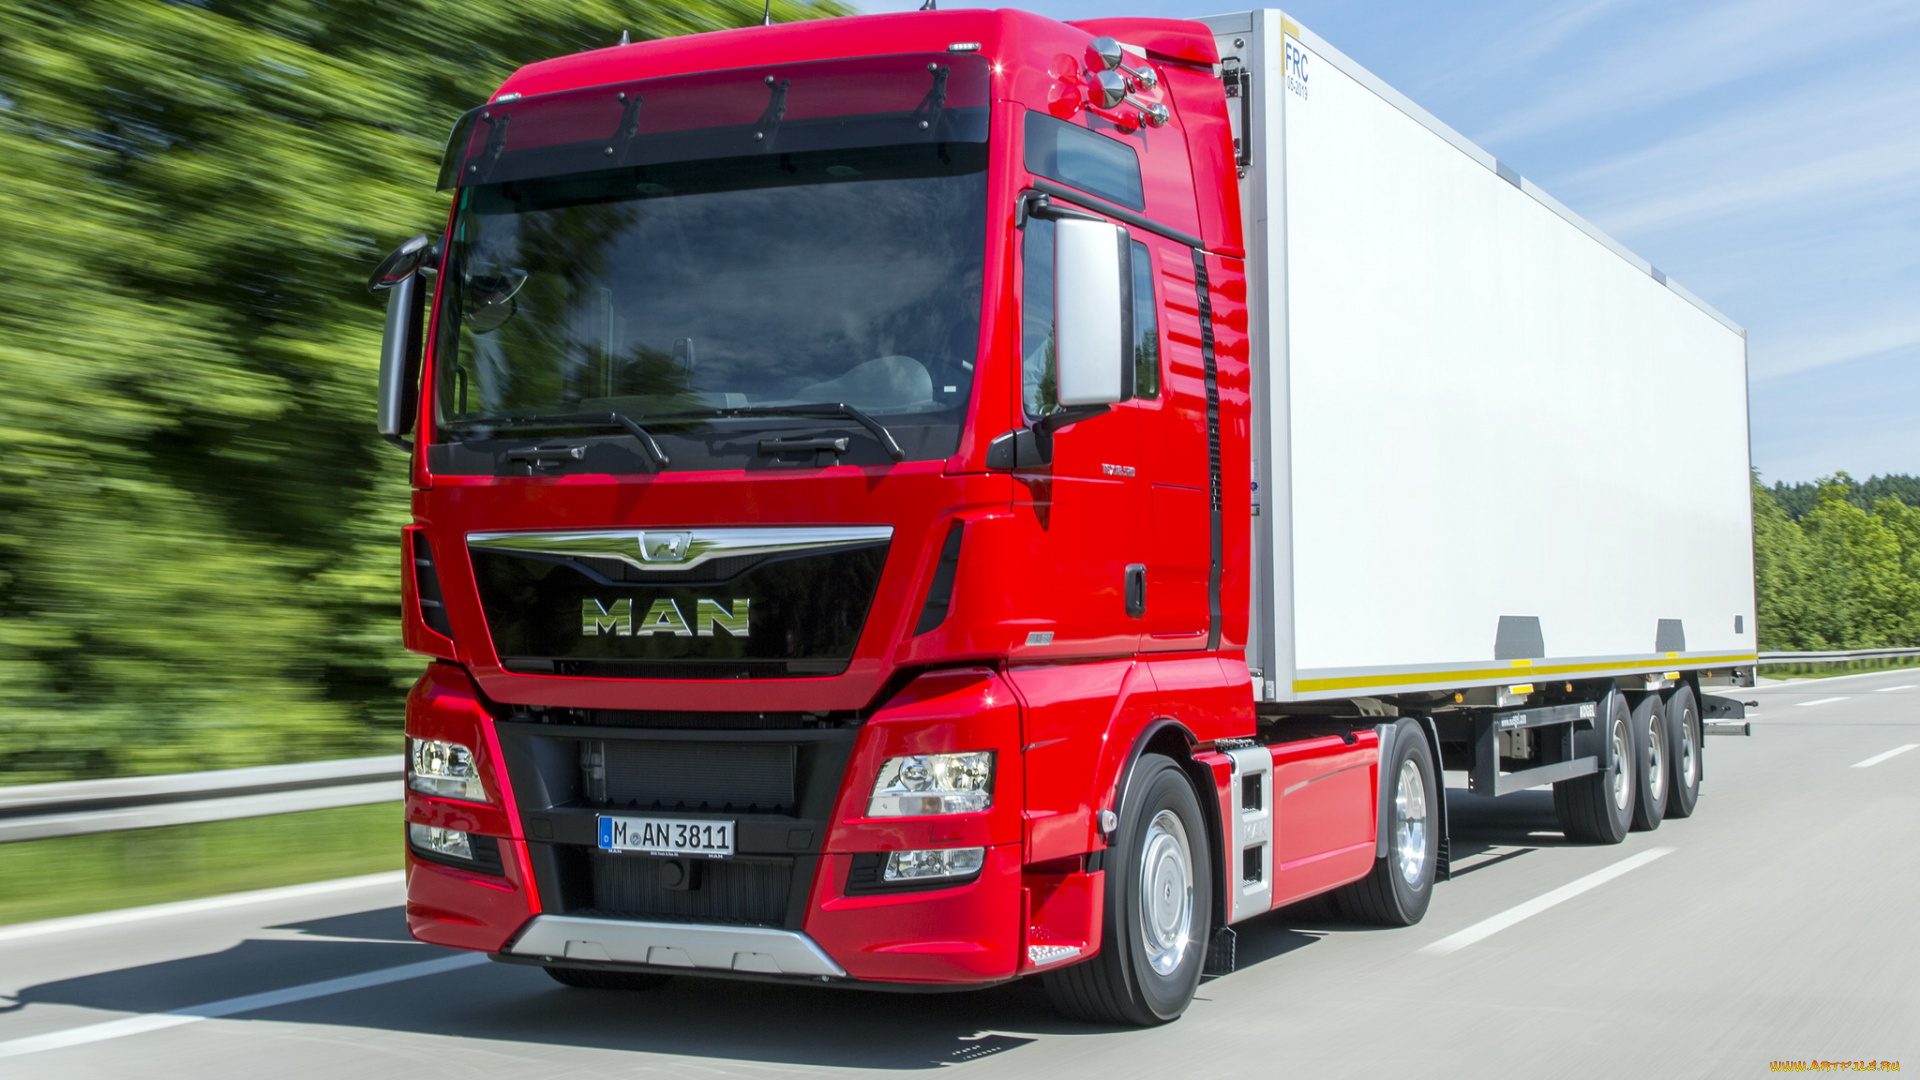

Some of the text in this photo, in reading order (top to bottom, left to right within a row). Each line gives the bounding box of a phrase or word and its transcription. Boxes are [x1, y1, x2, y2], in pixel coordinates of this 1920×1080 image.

[1286, 42, 1308, 83] FRC
[1287, 75, 1308, 100] 05-2019
[582, 598, 750, 636] MAN
[603, 835, 609, 843] D
[614, 821, 730, 850] M AN 3811
